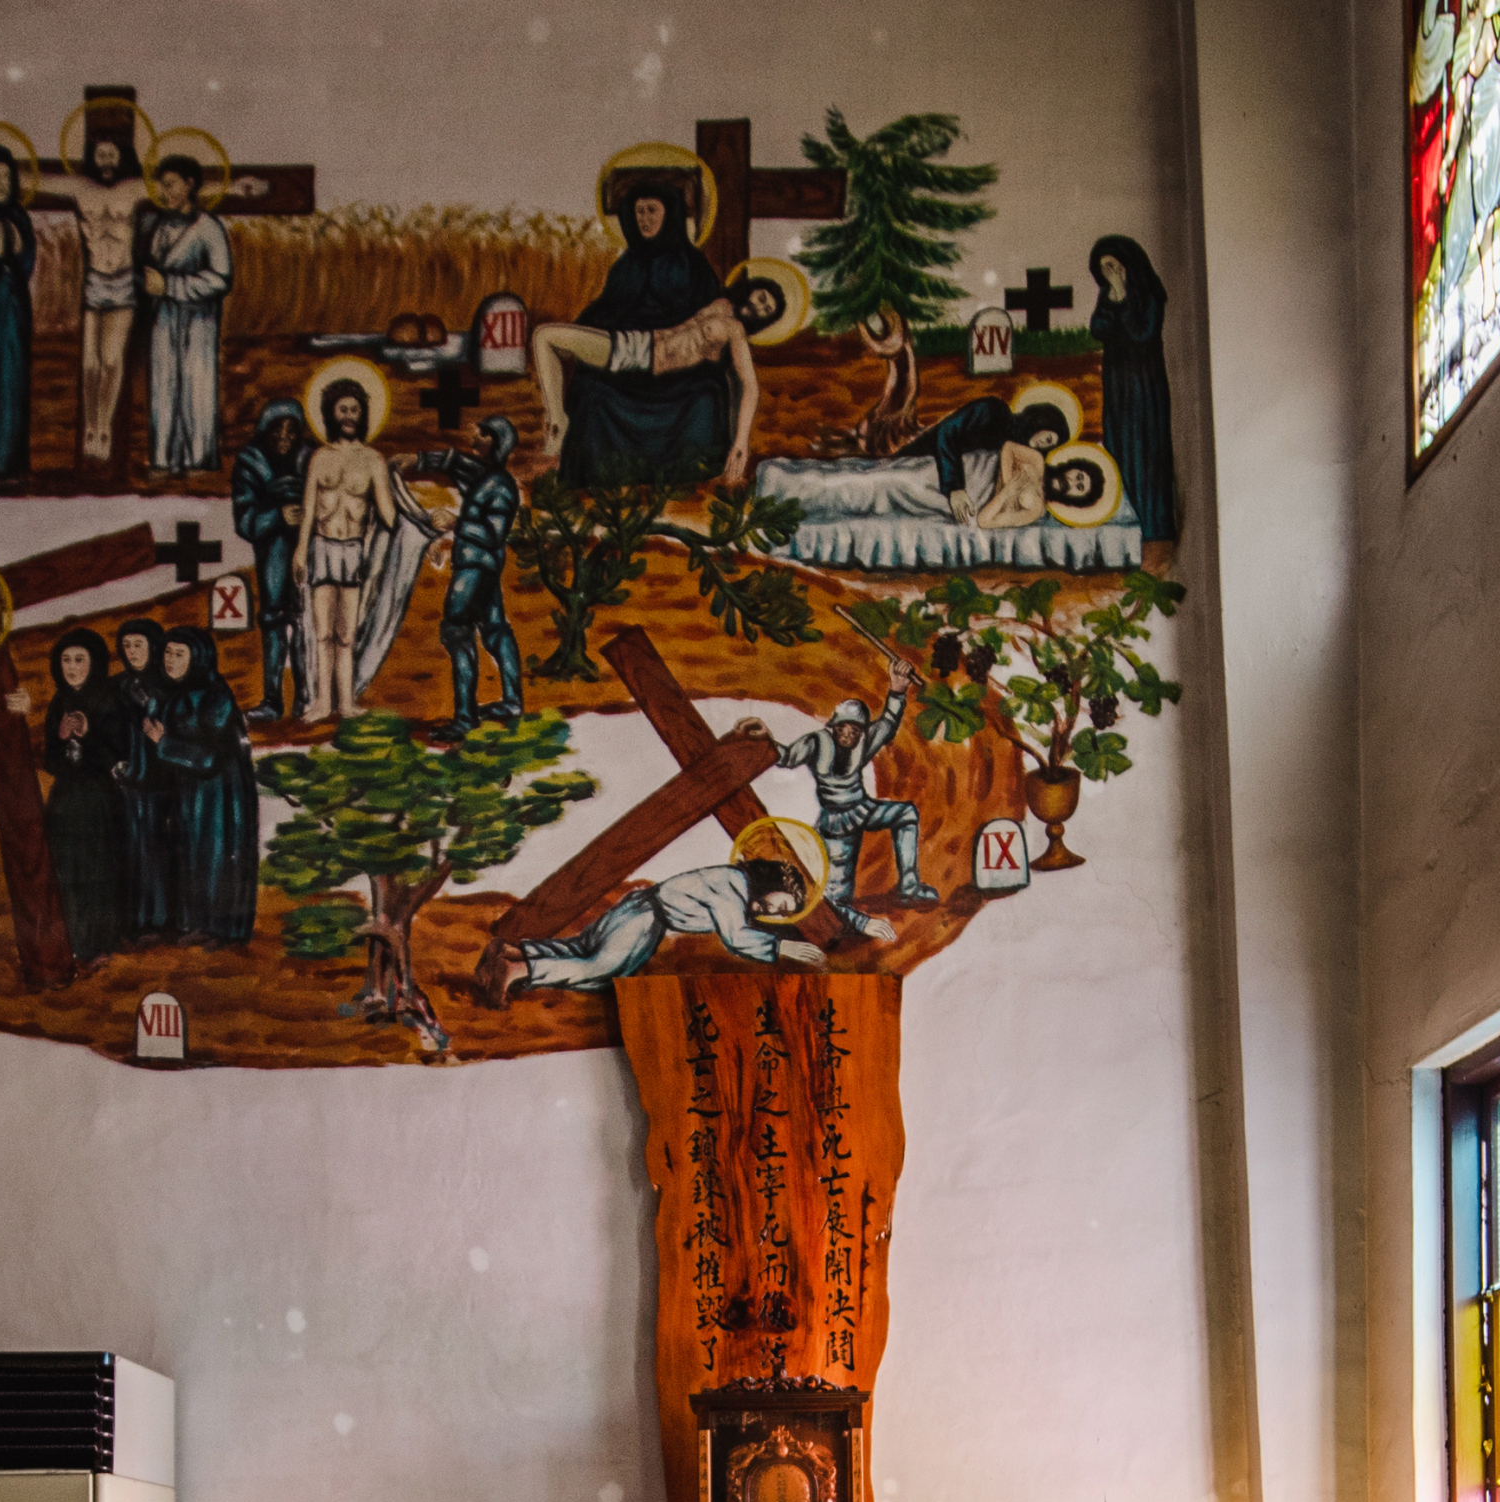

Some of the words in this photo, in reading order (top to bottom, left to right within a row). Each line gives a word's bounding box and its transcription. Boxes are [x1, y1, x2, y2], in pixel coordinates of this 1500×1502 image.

[482, 310, 527, 350] XIII
[974, 325, 1011, 356] XIV
[213, 585, 243, 620] X
[982, 831, 1021, 870] IX
[139, 1004, 181, 1038] VIII
